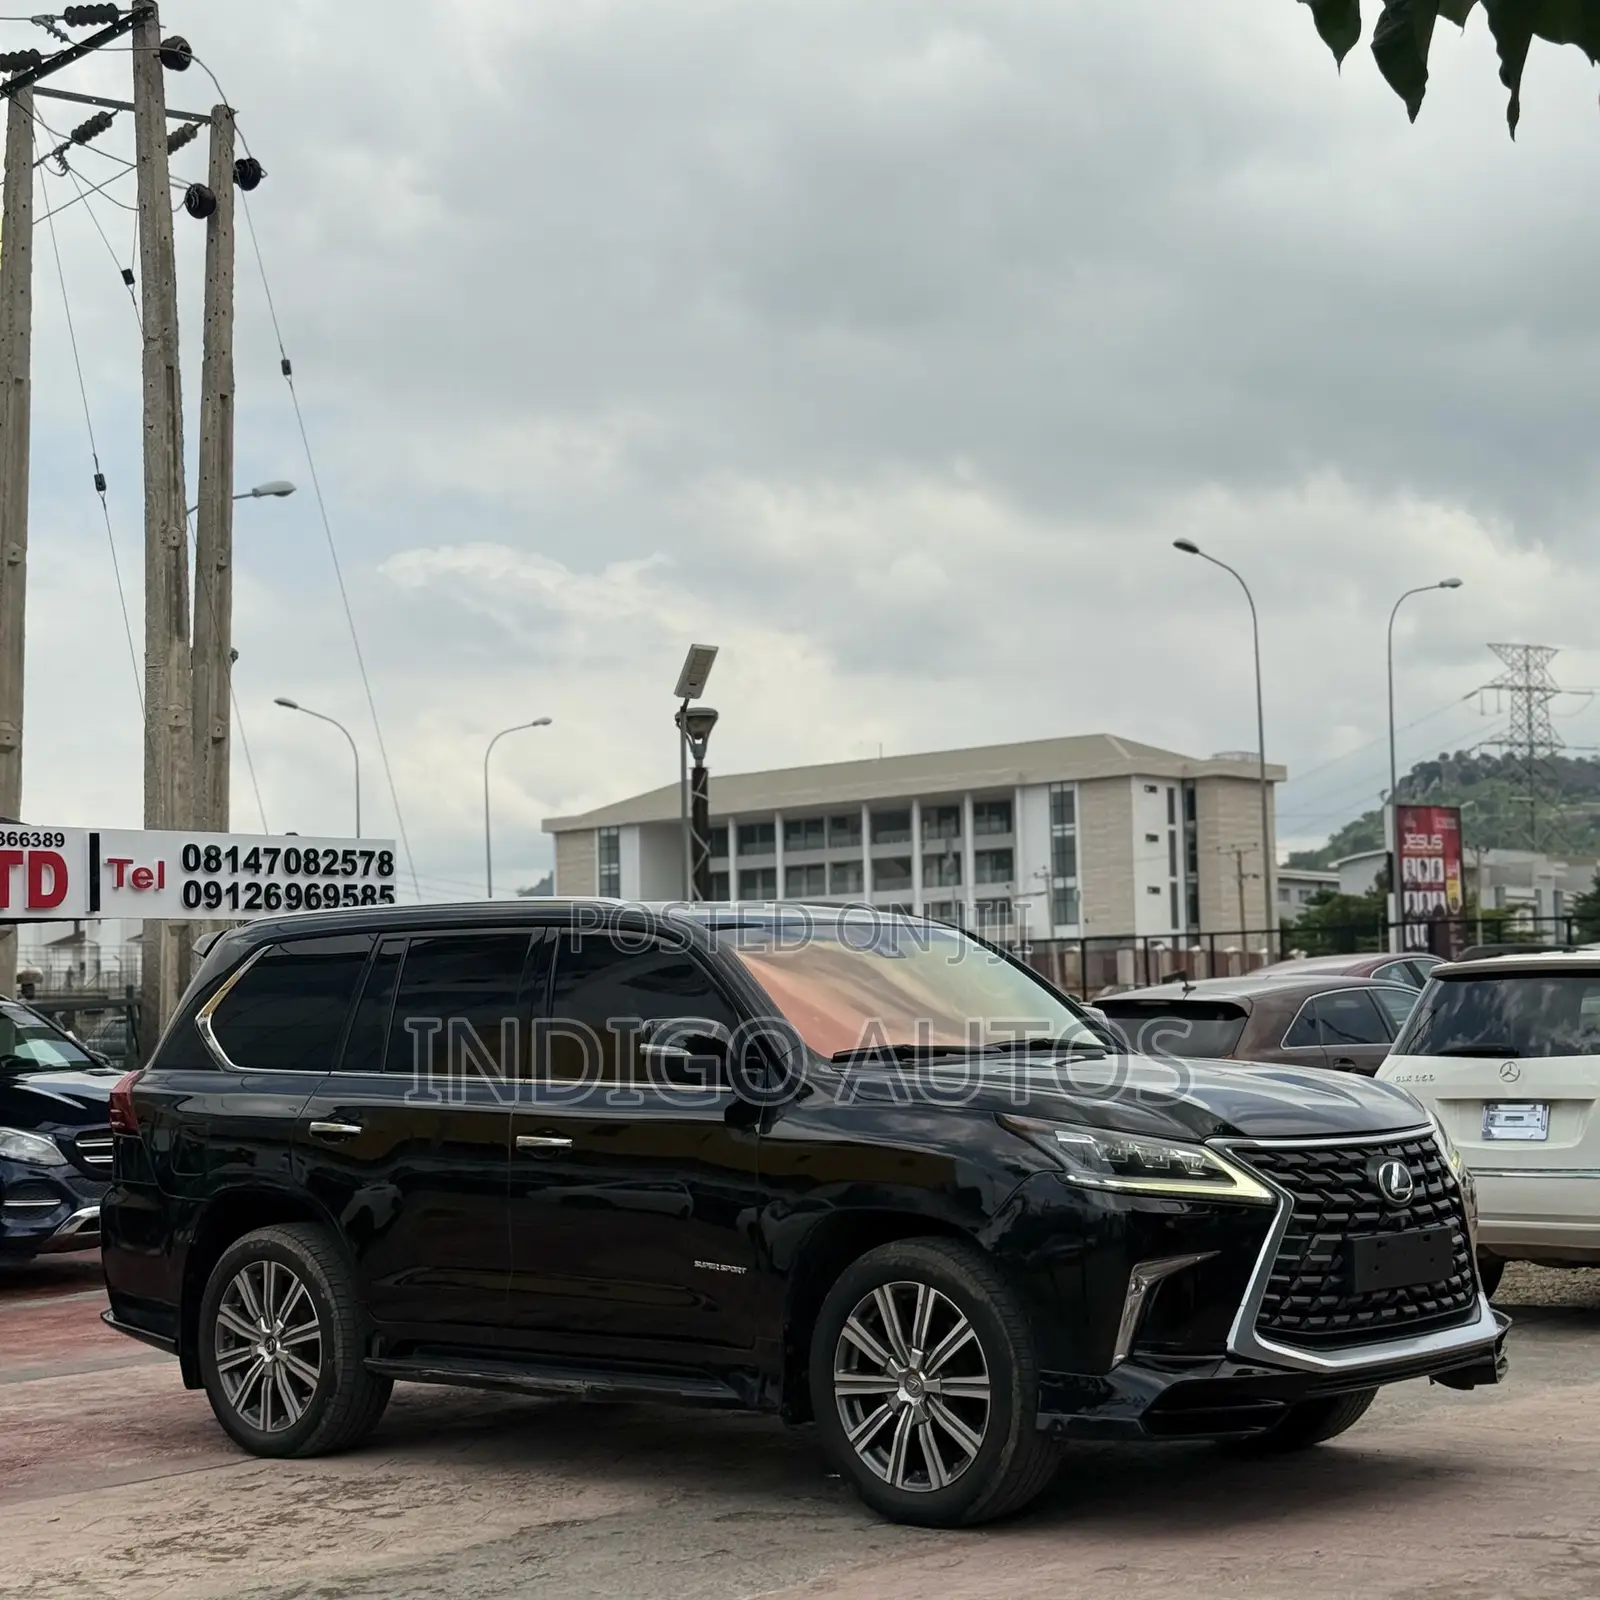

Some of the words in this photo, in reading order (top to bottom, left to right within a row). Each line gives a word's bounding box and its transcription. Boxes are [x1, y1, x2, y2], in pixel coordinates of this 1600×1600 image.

[106, 857, 165, 890] Tel
[181, 843, 394, 877] 08147082578
[181, 880, 395, 910] 09126969585
